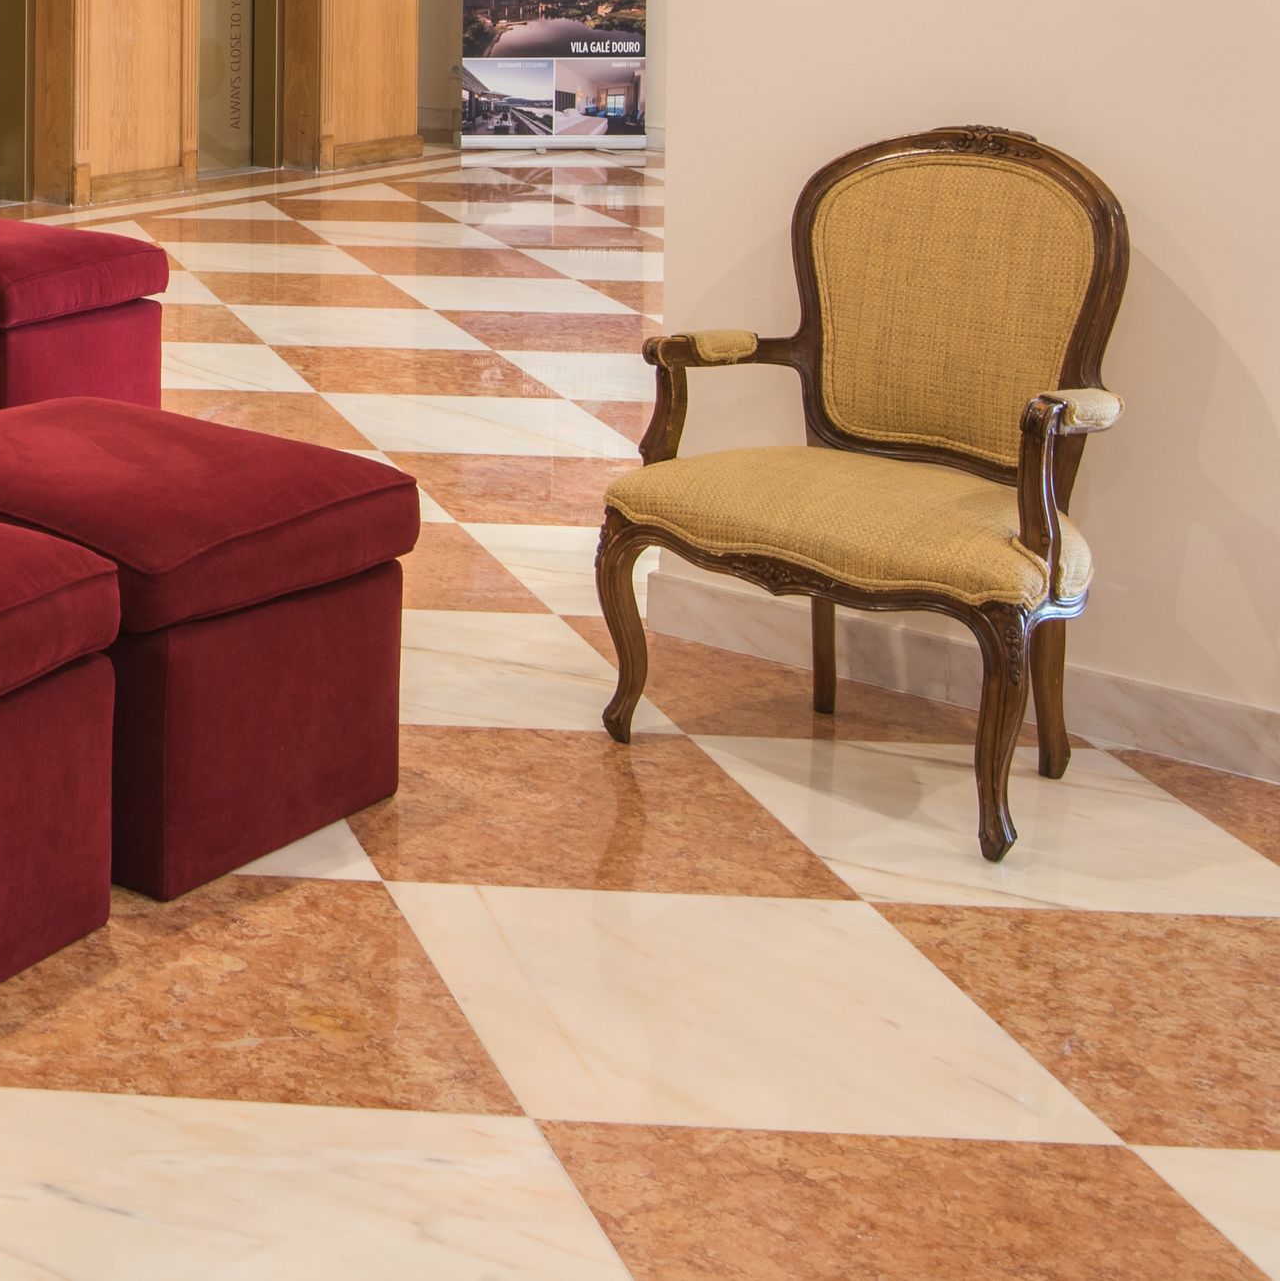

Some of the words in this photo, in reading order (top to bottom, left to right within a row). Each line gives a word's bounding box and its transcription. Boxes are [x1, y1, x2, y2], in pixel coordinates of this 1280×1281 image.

[230, 13, 242, 29] TO
[230, 31, 241, 72] CLOSE
[570, 41, 589, 53] VILA
[590, 39, 610, 53] GALÉ
[611, 41, 640, 53] DOURO
[230, 76, 241, 129] ALWAYS
